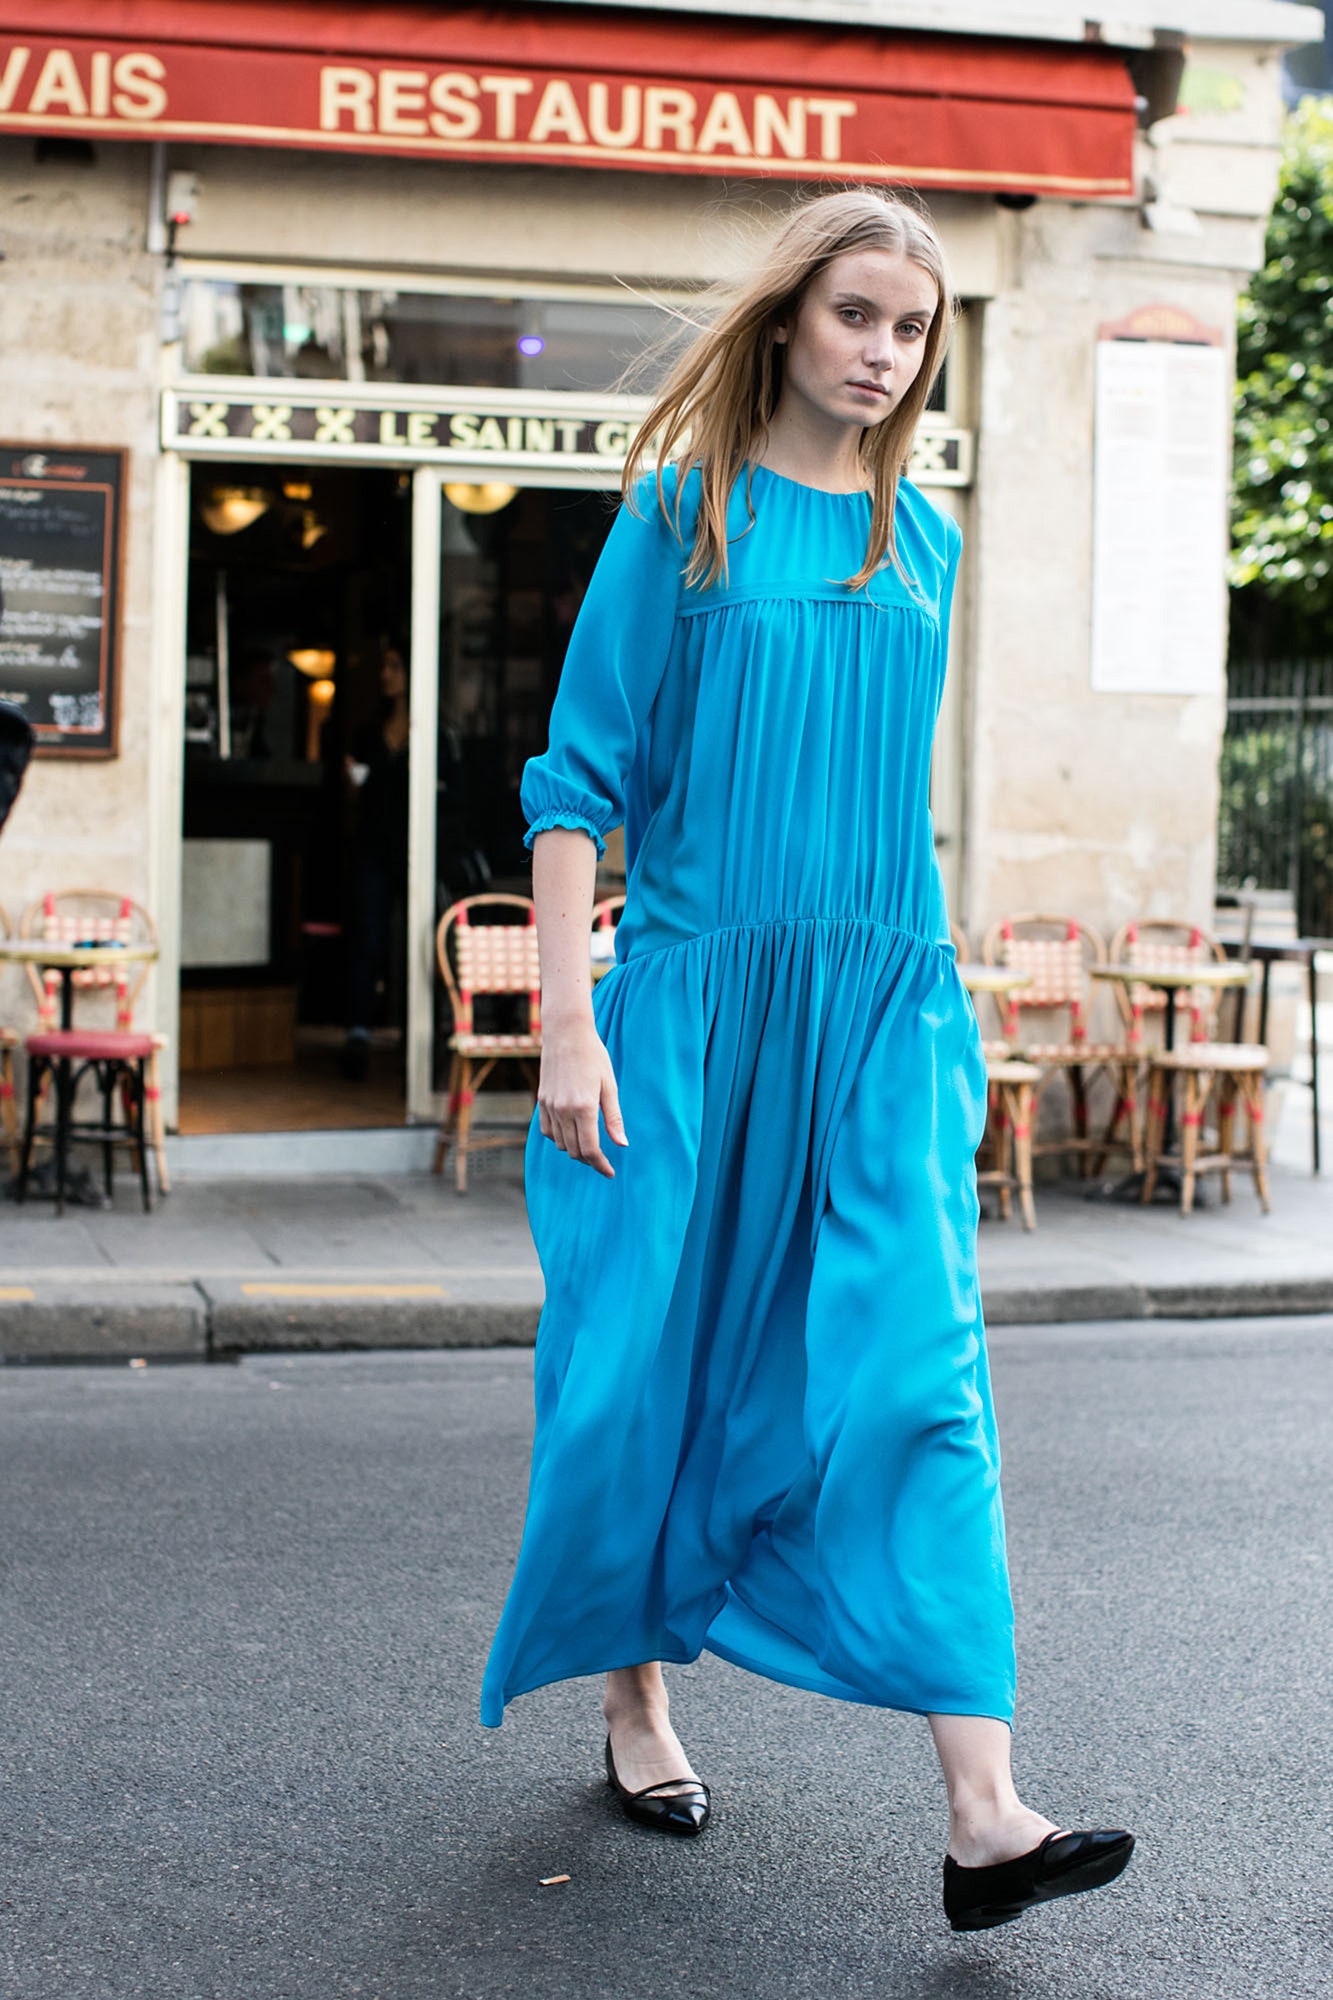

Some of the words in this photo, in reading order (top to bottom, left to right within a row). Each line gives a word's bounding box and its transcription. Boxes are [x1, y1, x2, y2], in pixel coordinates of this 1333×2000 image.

[319, 66, 856, 161] RESTAURANT
[379, 410, 439, 446] LE
[450, 414, 585, 453] SAINT
